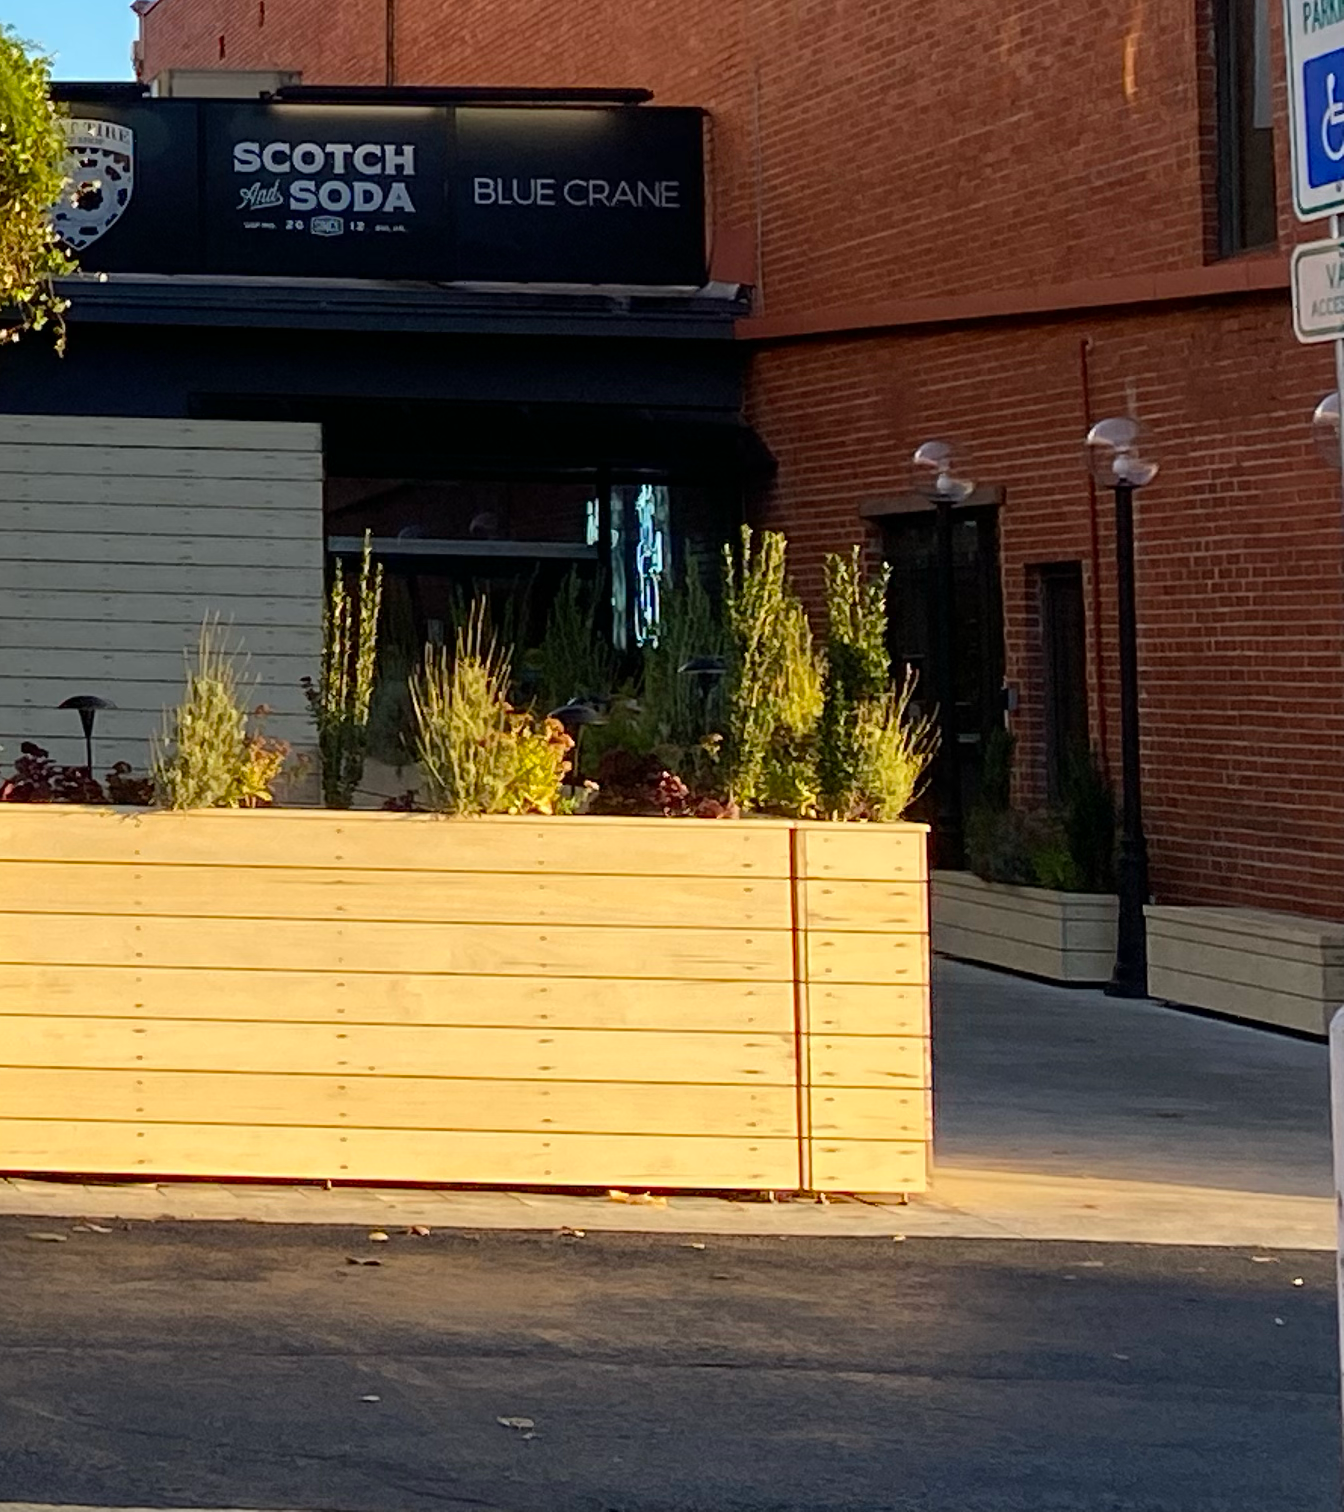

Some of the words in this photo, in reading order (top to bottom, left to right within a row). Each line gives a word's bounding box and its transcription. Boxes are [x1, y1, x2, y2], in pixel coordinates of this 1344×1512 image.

[233, 141, 416, 176] SCOTCH
[236, 179, 283, 210] And
[289, 180, 416, 213] SODA
[473, 177, 556, 206] BLUE
[563, 179, 681, 209] CRANE
